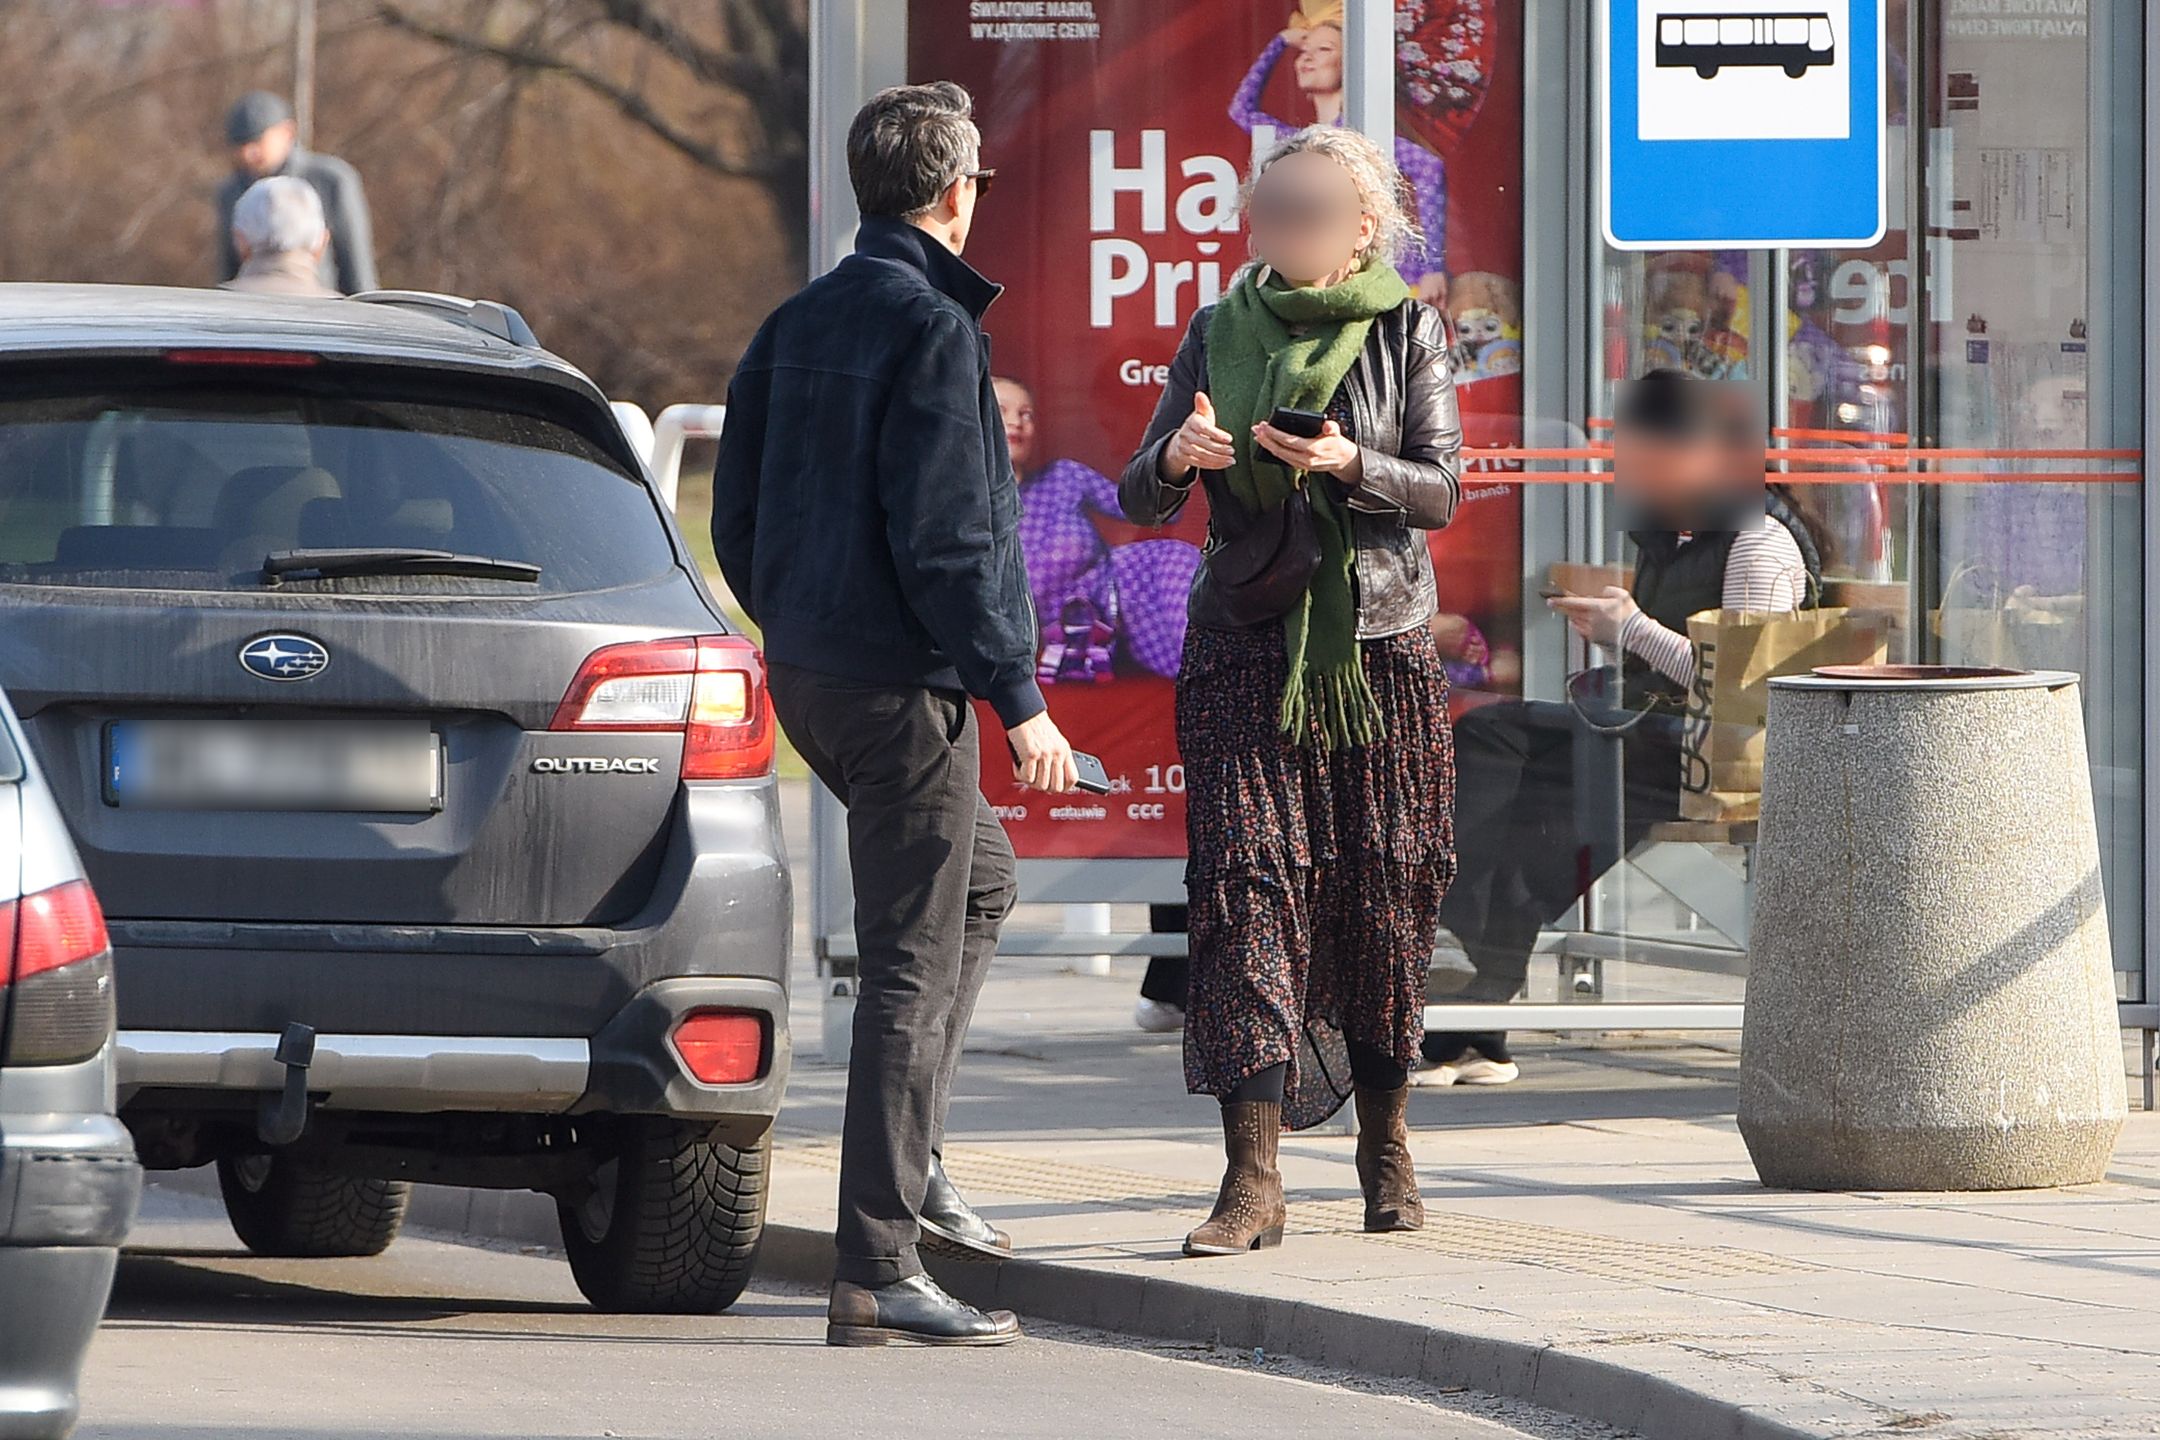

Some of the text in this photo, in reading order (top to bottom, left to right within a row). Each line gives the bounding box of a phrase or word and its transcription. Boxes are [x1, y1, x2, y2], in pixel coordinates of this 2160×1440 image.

[1119, 358, 1170, 386] Gre
[1464, 484, 1511, 501] brands
[532, 756, 660, 773] OUTBACK
